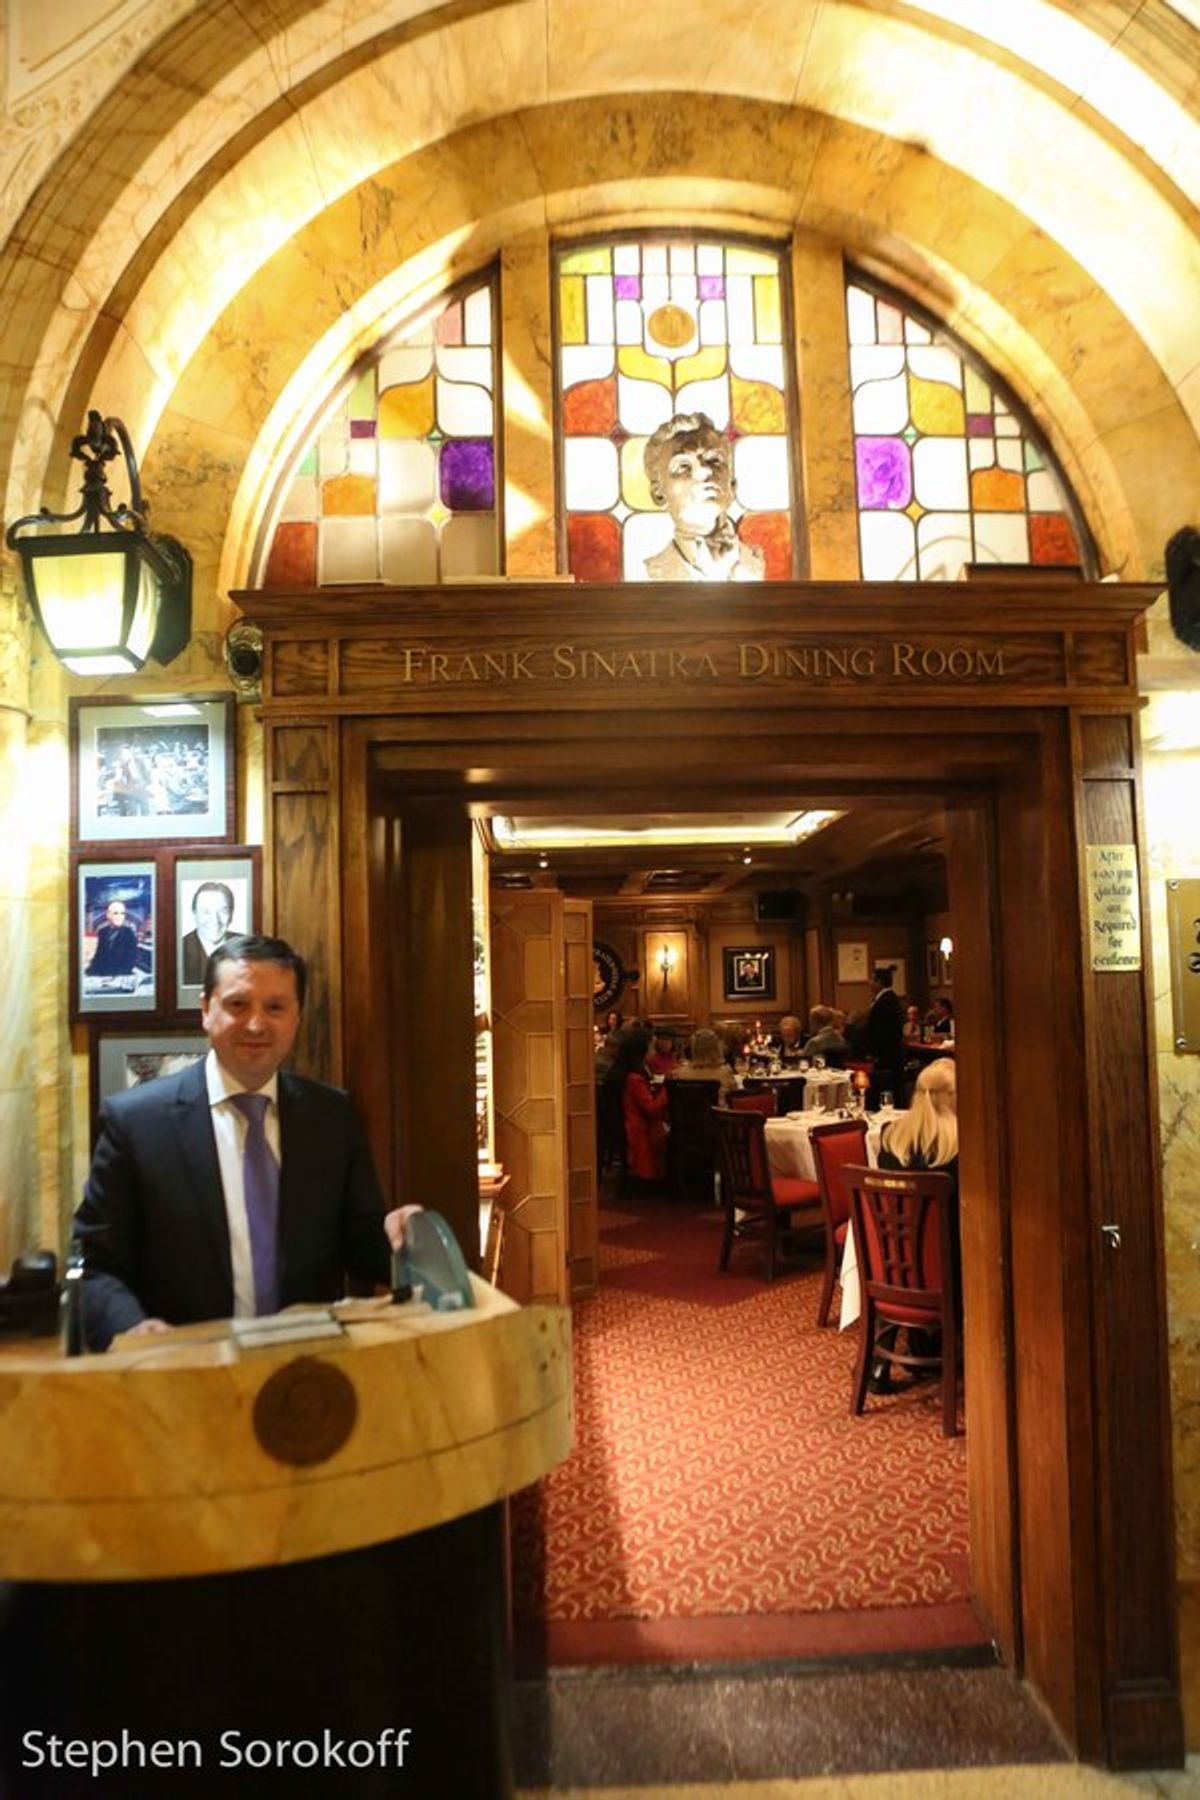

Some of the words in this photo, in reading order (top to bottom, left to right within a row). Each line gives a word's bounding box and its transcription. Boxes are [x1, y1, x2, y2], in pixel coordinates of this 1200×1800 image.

[403, 649, 535, 681] FRANK
[553, 644, 720, 680] SINATRA
[738, 643, 877, 677] DINING
[893, 643, 1006, 677] ROOM
